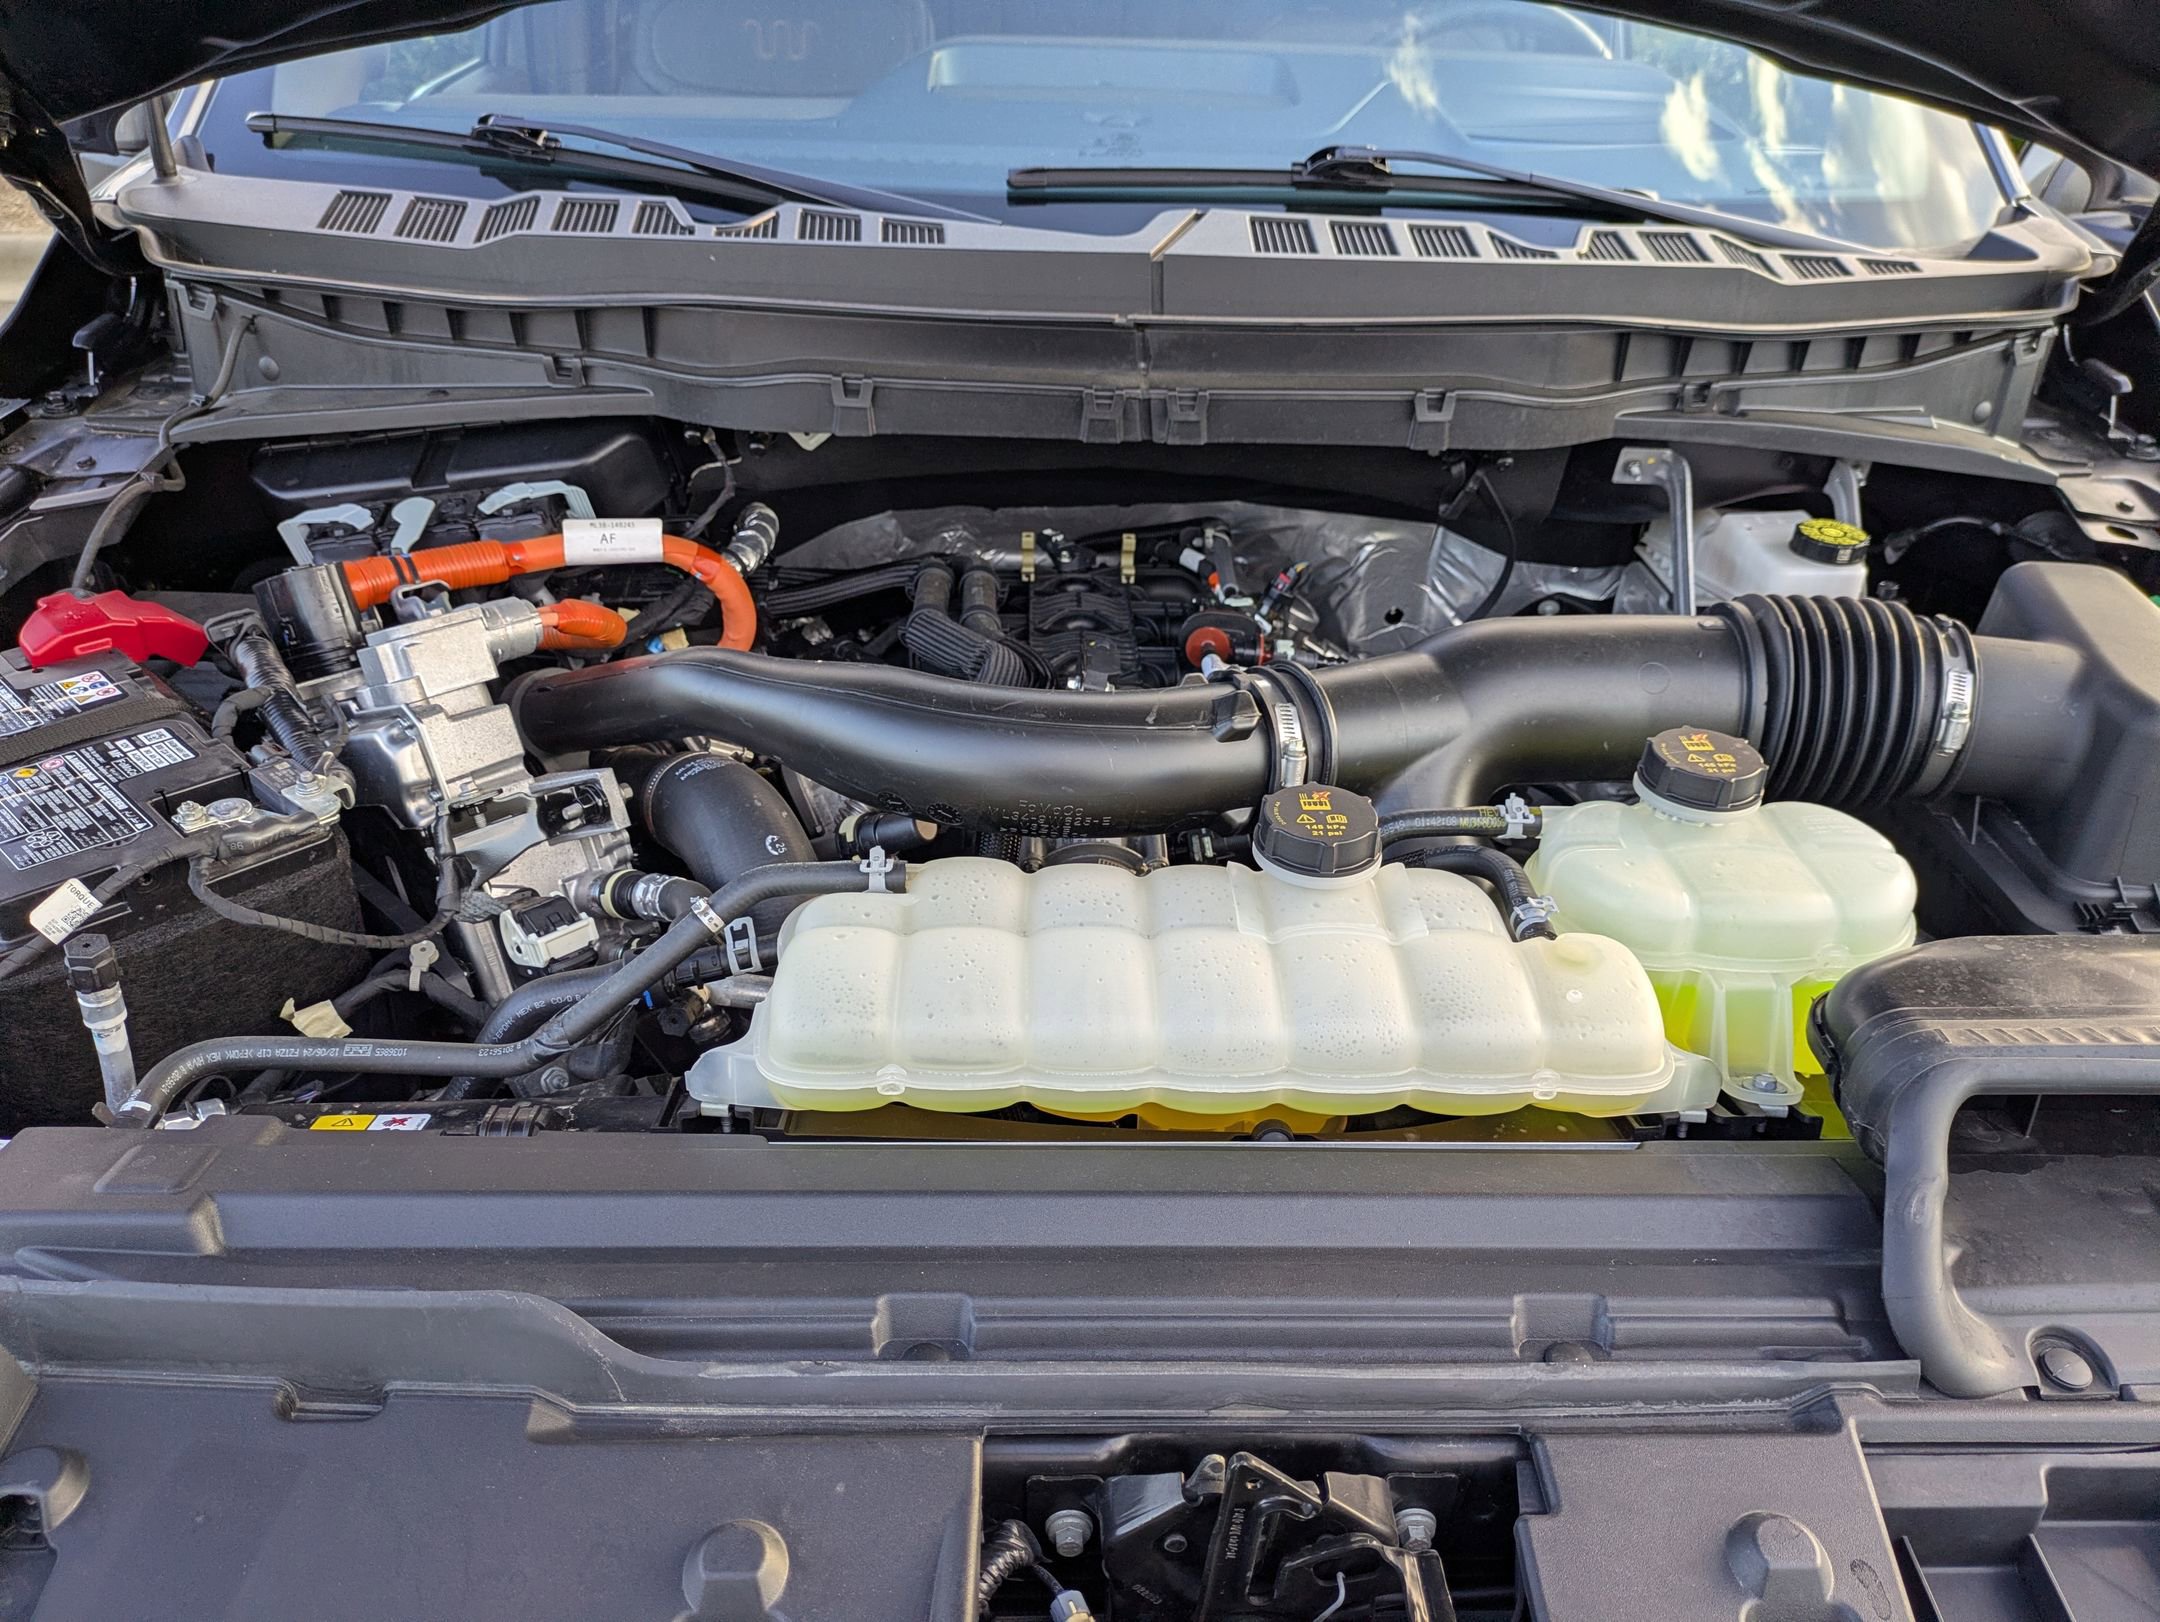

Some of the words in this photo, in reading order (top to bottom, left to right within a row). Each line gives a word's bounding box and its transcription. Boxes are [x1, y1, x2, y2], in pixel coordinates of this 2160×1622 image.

[600, 533, 617, 544] AF
[66, 883, 95, 909] TORQUE
[478, 1045, 514, 1057] 20:56:23
